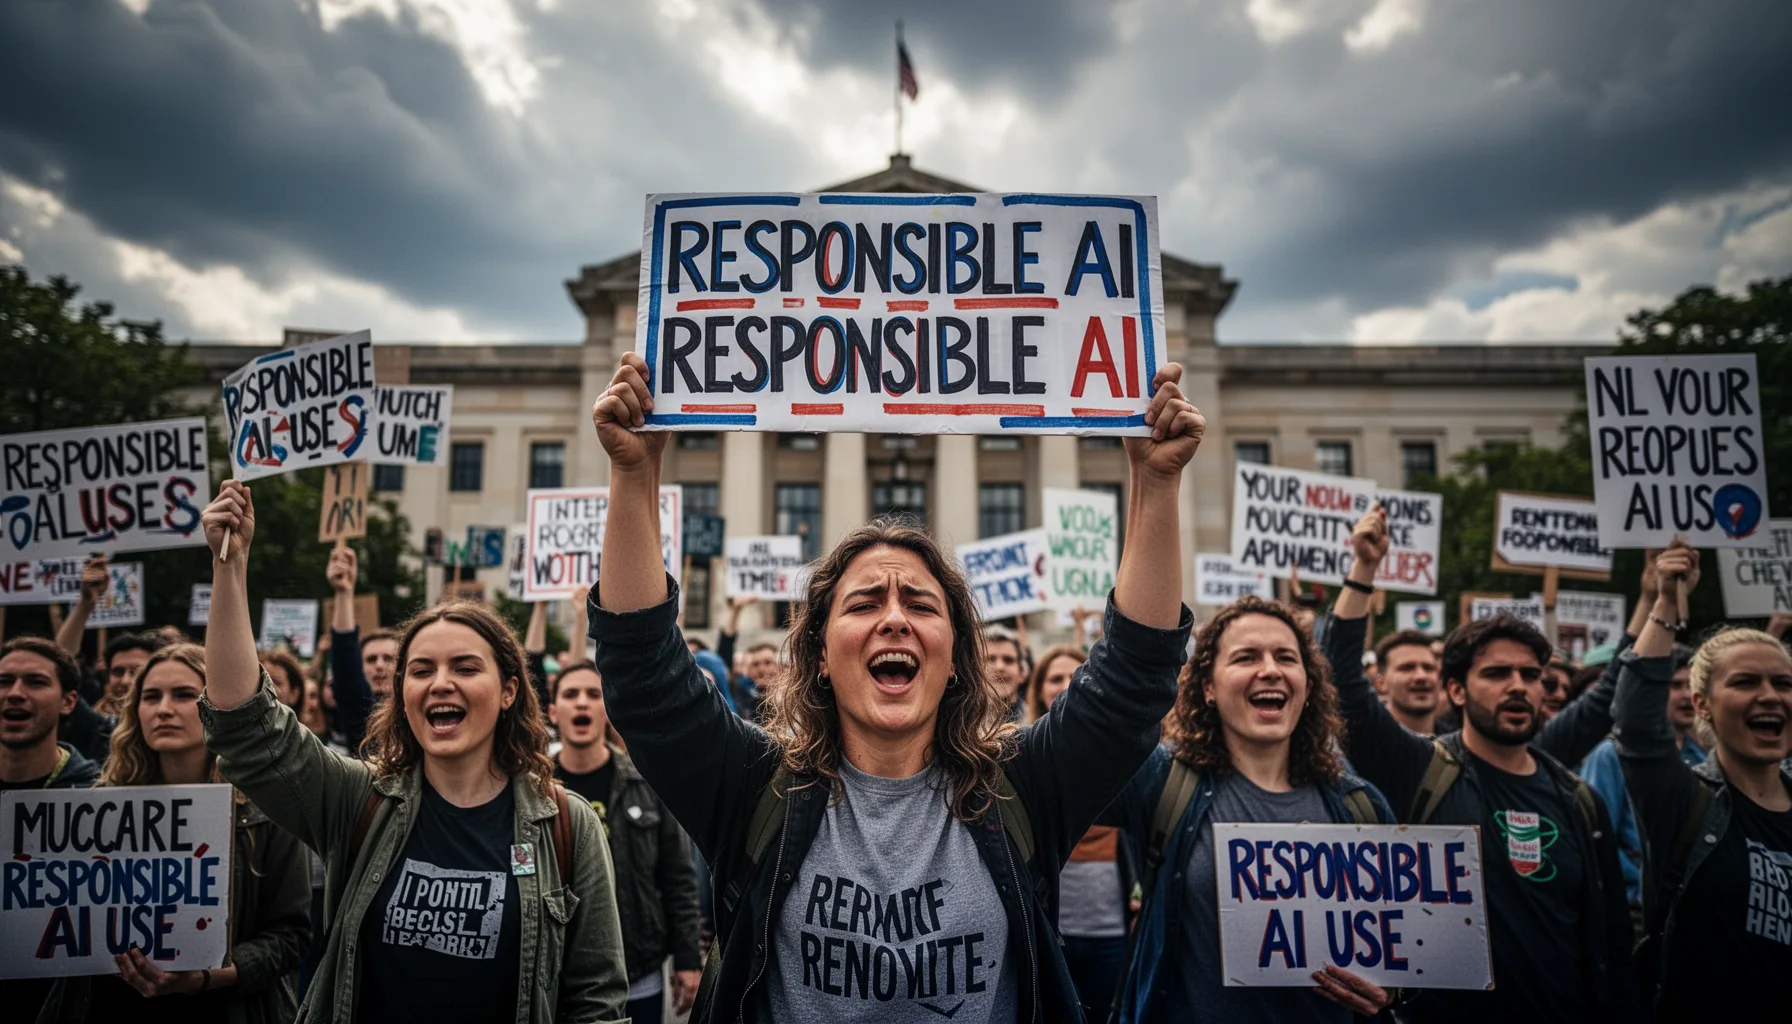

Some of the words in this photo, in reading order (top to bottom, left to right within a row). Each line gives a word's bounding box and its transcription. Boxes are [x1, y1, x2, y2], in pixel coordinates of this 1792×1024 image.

[668, 220, 1042, 294] RESPONSIBLE
[1064, 220, 1133, 298] AI
[661, 315, 1046, 397] RESPONSIBLE
[1070, 316, 1140, 398] AI
[222, 341, 373, 453] RSPONSIBLE
[1594, 366, 1649, 417] NL
[1654, 367, 1753, 417] VOUR
[4, 427, 205, 491] RESPONSIBLE
[1599, 425, 1758, 479] REOPUES
[1241, 470, 1302, 506] YOUR
[1624, 482, 1663, 531] AI
[13, 799, 194, 854] MUCCARE
[3, 856, 220, 911] RESPONSIBLE
[1228, 838, 1473, 904] RESPONSIBLE
[35, 905, 92, 959] AI
[1258, 908, 1307, 969] AI
